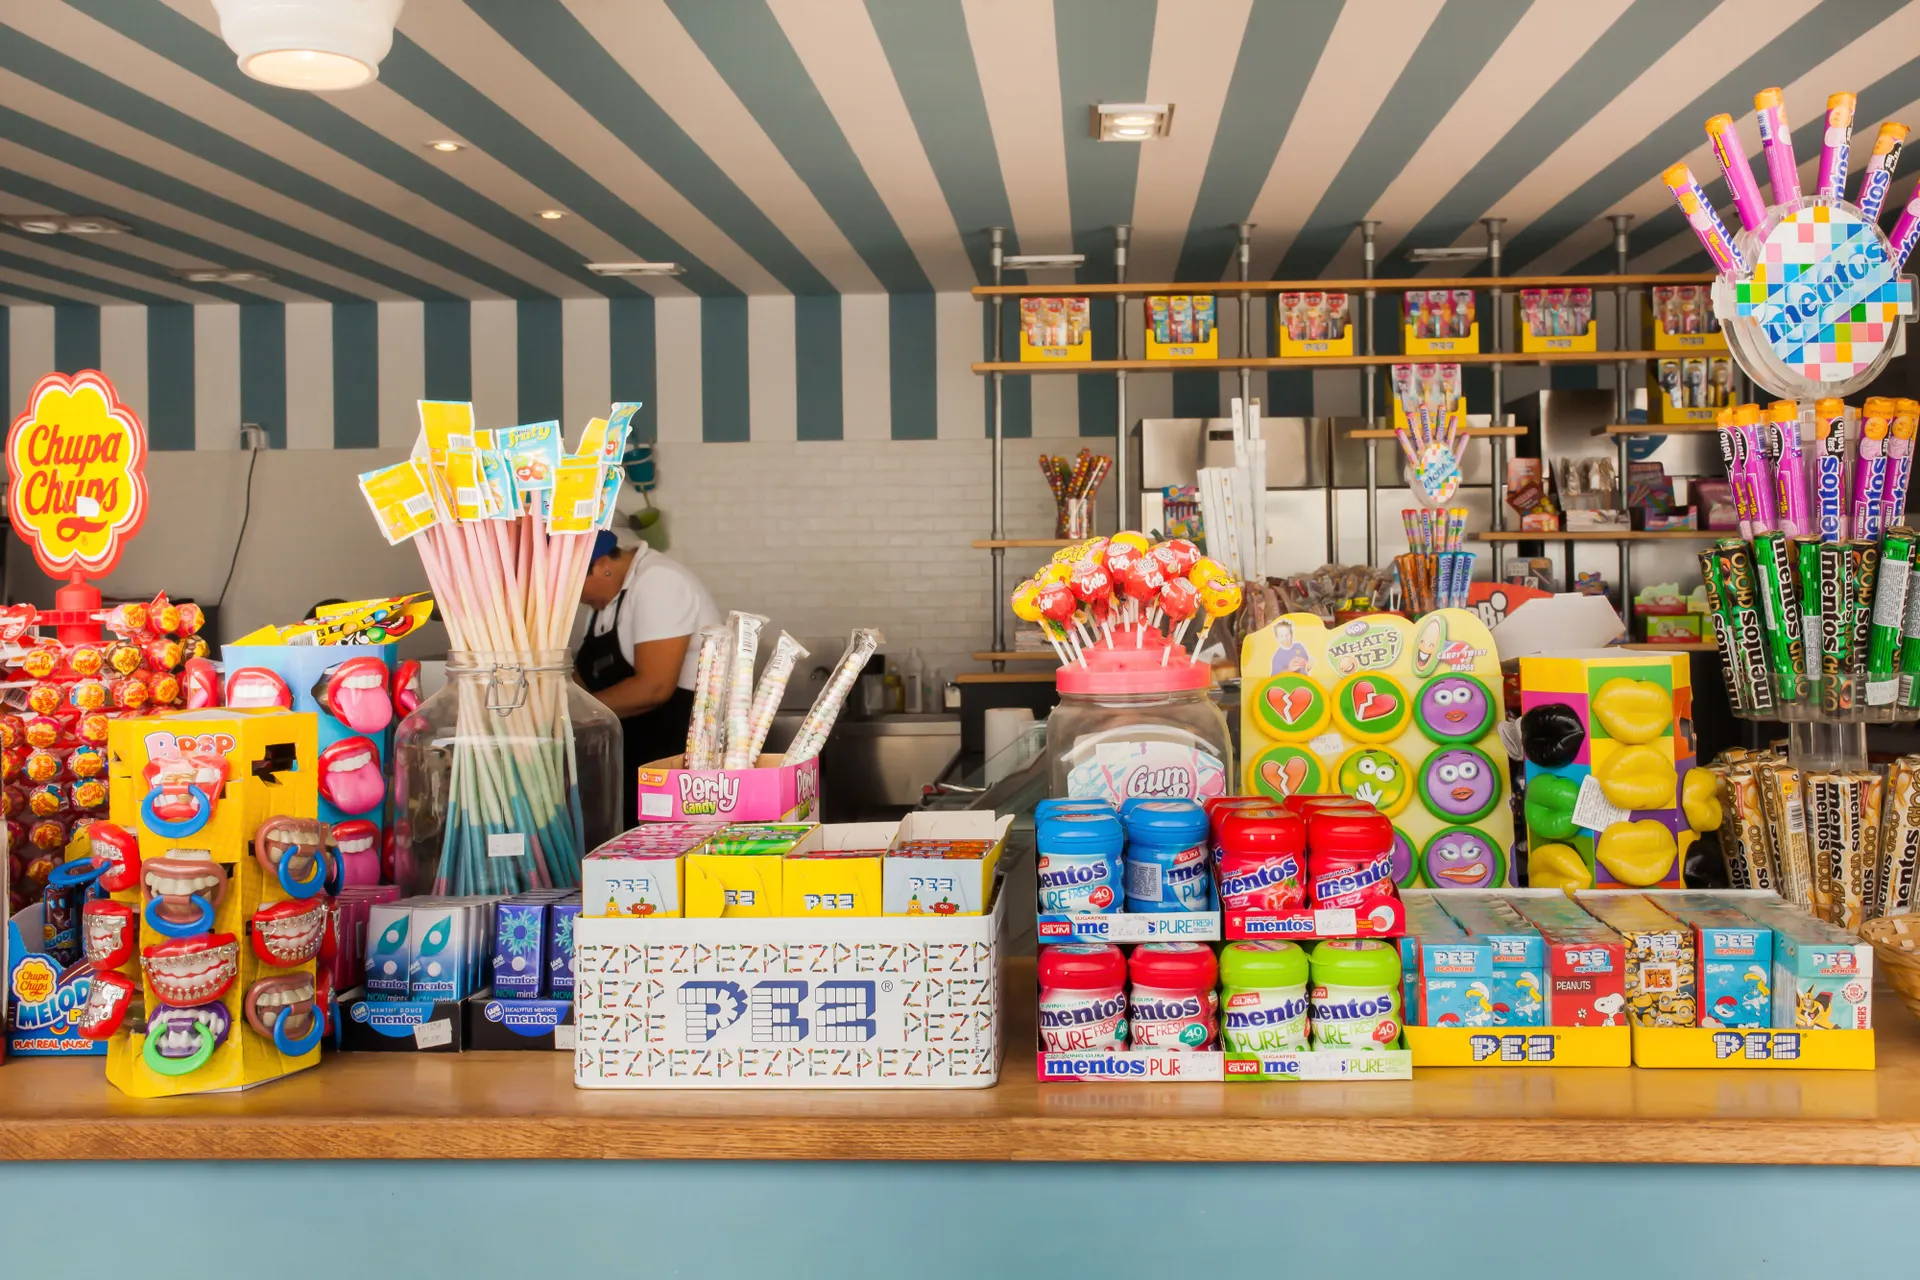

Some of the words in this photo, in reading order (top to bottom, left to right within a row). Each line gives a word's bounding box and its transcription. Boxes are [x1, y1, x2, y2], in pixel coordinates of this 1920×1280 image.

[1762, 240, 1888, 344] mentos
[28, 425, 122, 476] Chupa
[1080, 573, 1107, 595] Cola
[1731, 553, 1753, 609] CHOCO
[1859, 549, 1876, 606] CHOCO
[1773, 538, 1800, 640] mentos
[1821, 552, 1838, 653] mentos
[1330, 630, 1398, 658] WHAT'S
[1355, 645, 1395, 667] UP!
[1740, 610, 1772, 709] mentos
[1823, 655, 1838, 712] CHOCO
[1127, 765, 1189, 796] Gum
[678, 772, 740, 812] Perly
[682, 801, 716, 815] Candy
[1816, 783, 1829, 850] mentos
[1850, 783, 1860, 852] mentos
[1828, 782, 1845, 881] mentos
[605, 879, 650, 892] PEZ
[909, 877, 953, 892] PEZ
[724, 890, 755, 905] EZ
[1094, 888, 1109, 899] 40
[804, 894, 854, 910] PEZ
[1160, 920, 1193, 934] PURE
[1193, 919, 1213, 927] FRESH
[1246, 919, 1313, 932] mentos
[1635, 935, 1678, 950] PEZ
[1713, 934, 1755, 947] PEZ
[1434, 951, 1475, 965] PEZ
[1565, 951, 1606, 965] PEZ
[1811, 953, 1852, 966] PEZ
[22, 972, 48, 982] Chupa
[368, 979, 408, 989] mentos
[496, 975, 539, 984] mentos
[20, 981, 48, 993] Chups
[413, 982, 453, 990] mentos
[1556, 981, 1591, 990] PEANUTS
[516, 990, 537, 998] mints
[18, 977, 92, 1029] MELOD
[677, 980, 876, 1042] PEZ
[1042, 993, 1126, 1027] mentos
[1131, 997, 1200, 1020] entos
[371, 1014, 422, 1024] mentos
[506, 1013, 557, 1024] mentos
[1186, 1027, 1202, 1037] 40
[1378, 1024, 1394, 1035] 40
[13, 1039, 33, 1050] PLAY
[36, 1039, 59, 1050] REAL
[62, 1038, 93, 1050] MUSIC
[1047, 1028, 1096, 1051] PURE
[1236, 1029, 1288, 1052] PURE
[1712, 1032, 1801, 1061] PEZ
[1469, 1034, 1555, 1062] PEZ
[1046, 1056, 1146, 1075] mentos
[1350, 1059, 1385, 1073] PURE
